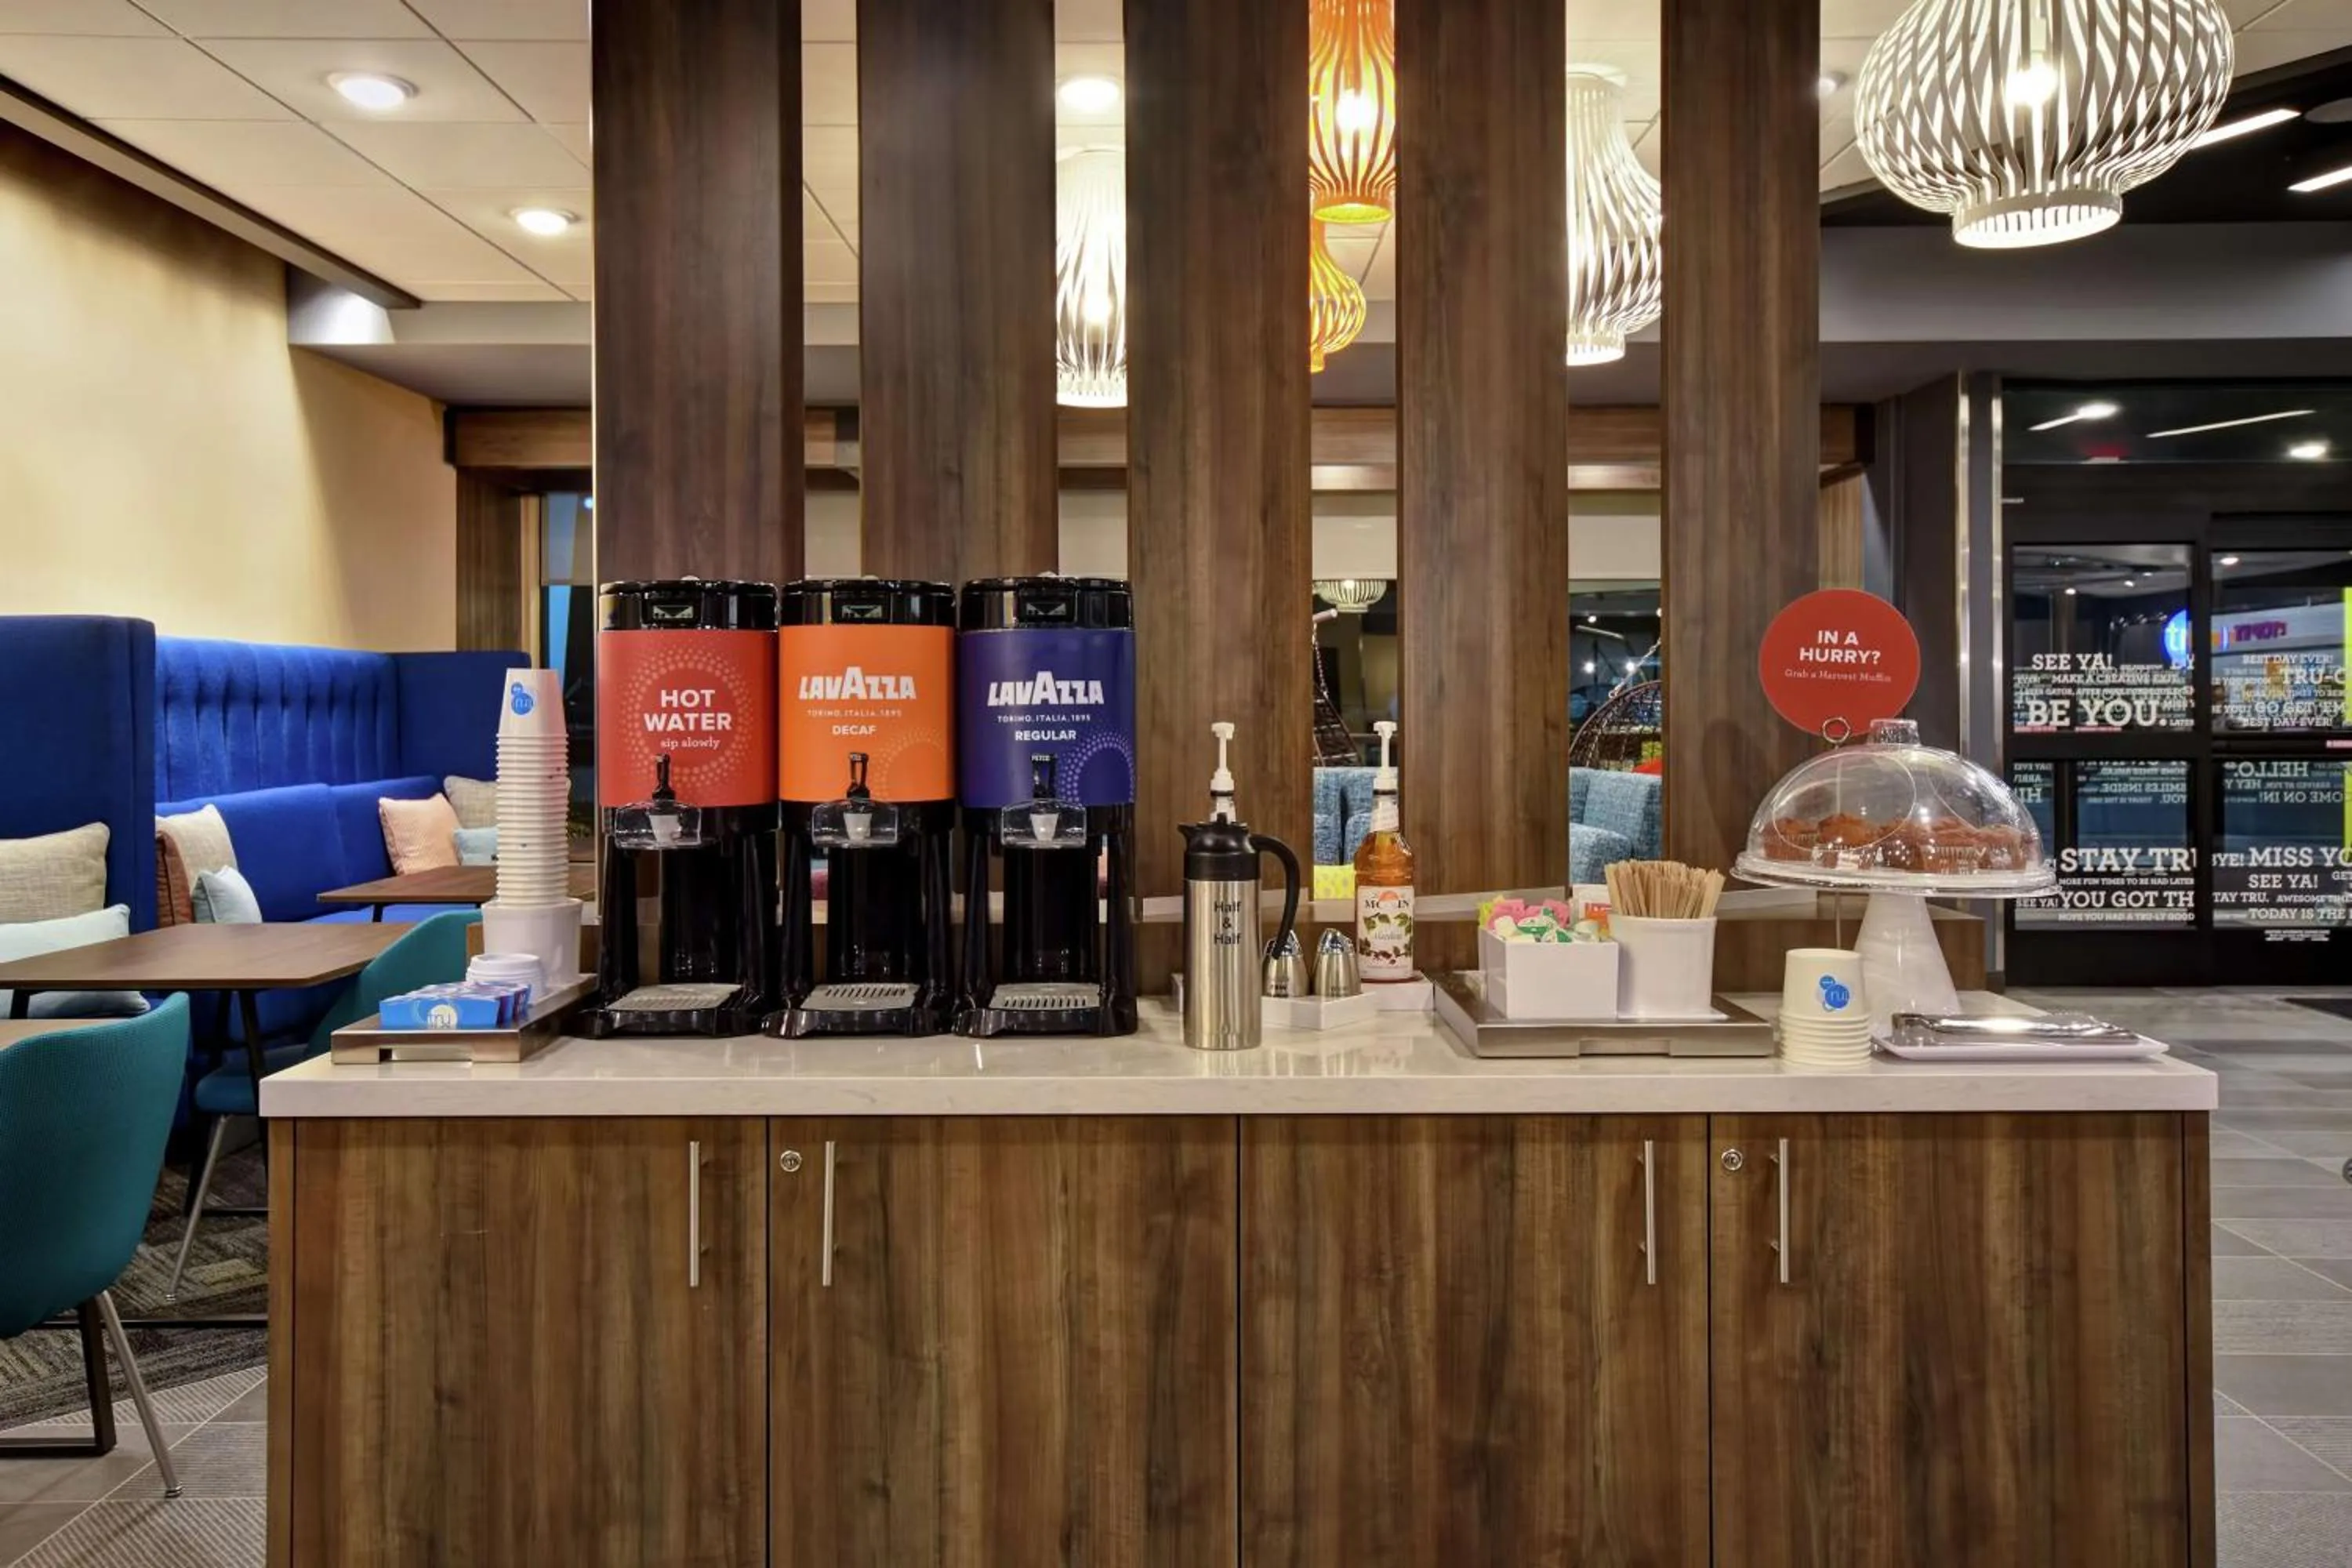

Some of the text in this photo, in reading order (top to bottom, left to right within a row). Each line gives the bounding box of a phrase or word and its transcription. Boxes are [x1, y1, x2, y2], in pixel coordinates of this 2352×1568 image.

[1818, 630, 1859, 645] IN A
[1799, 647, 1881, 665] HURRY?
[2032, 652, 2112, 670] SEE YA!
[799, 666, 916, 699] LAVAZZA
[1784, 669, 1809, 678] Grab
[1818, 670, 1857, 681] Harvest
[987, 671, 1104, 706] LAVAZZA
[661, 689, 715, 707] HOT
[2027, 699, 2071, 727] BE
[2079, 699, 2168, 727] YOU.
[644, 713, 732, 731] WATER
[2273, 717, 2296, 727] DAY
[832, 725, 877, 735] DECAF
[1015, 730, 1076, 741] REGULAR
[660, 735, 720, 750] sip slowly
[2060, 848, 2141, 872] STAY
[2249, 847, 2314, 867] MISS
[2248, 873, 2318, 889] SEE YA!
[1214, 900, 1241, 913] Half
[2039, 898, 2058, 908] YA!
[2060, 890, 2107, 909] YOU
[2111, 890, 2158, 908] GOT
[2248, 908, 2297, 920] TODAY
[2300, 908, 2314, 920] IS
[1222, 916, 1231, 929] &
[1214, 932, 1241, 945] Half
